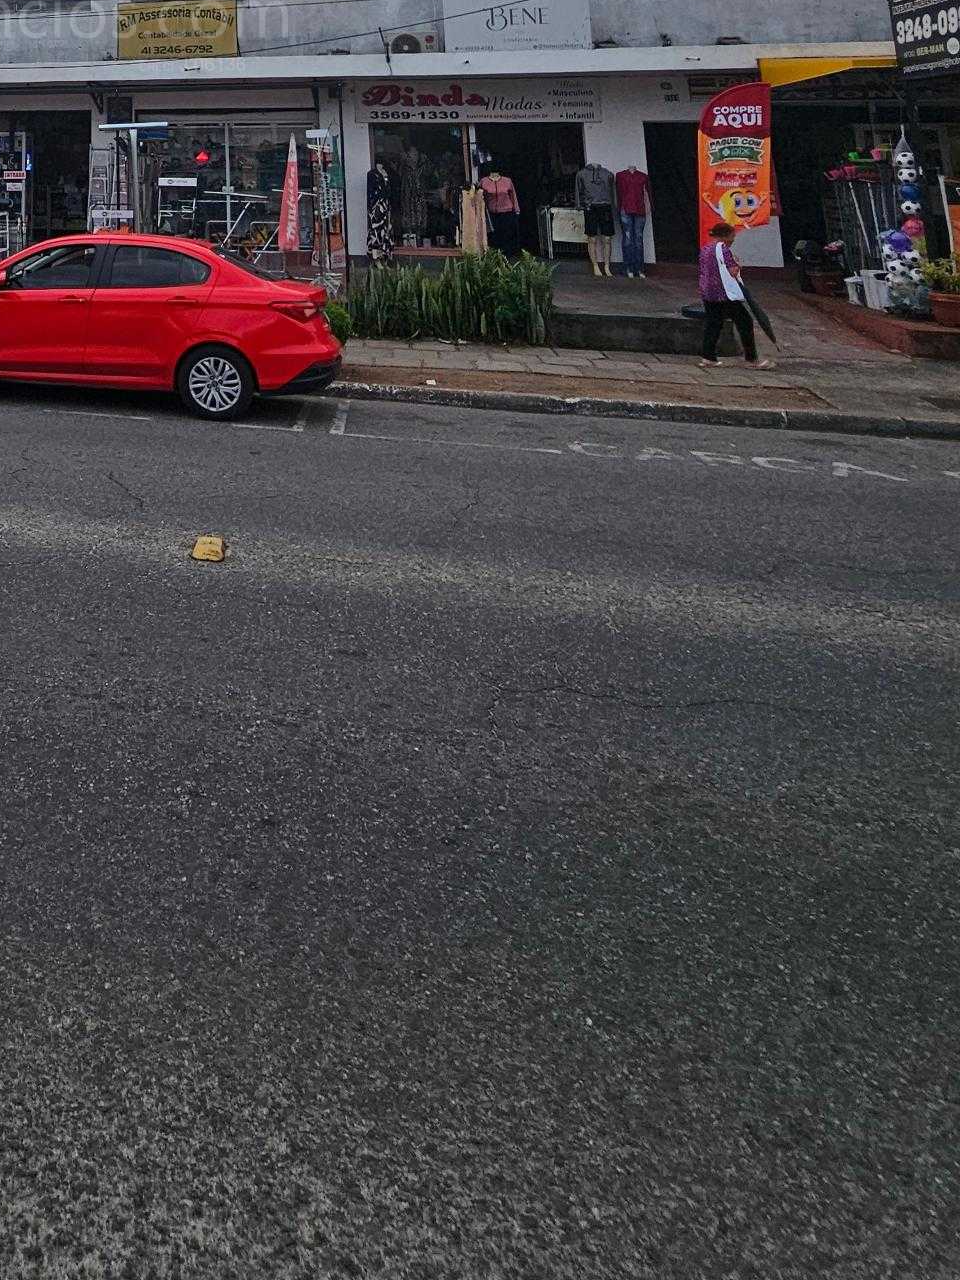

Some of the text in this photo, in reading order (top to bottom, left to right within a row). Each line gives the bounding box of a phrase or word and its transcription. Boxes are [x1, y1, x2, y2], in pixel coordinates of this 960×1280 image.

[138, 6, 191, 22] Assessoria
[486, 7, 550, 32] BENE
[896, 6, 960, 45] 3248-08
[154, 44, 214, 55] 3246-6792
[362, 84, 544, 112] Dinda Modas
[370, 110, 460, 120] 3569-1330
[713, 105, 763, 114] COMPRE
[713, 112, 763, 129] AQUI
[709, 137, 739, 150] PAGUE
